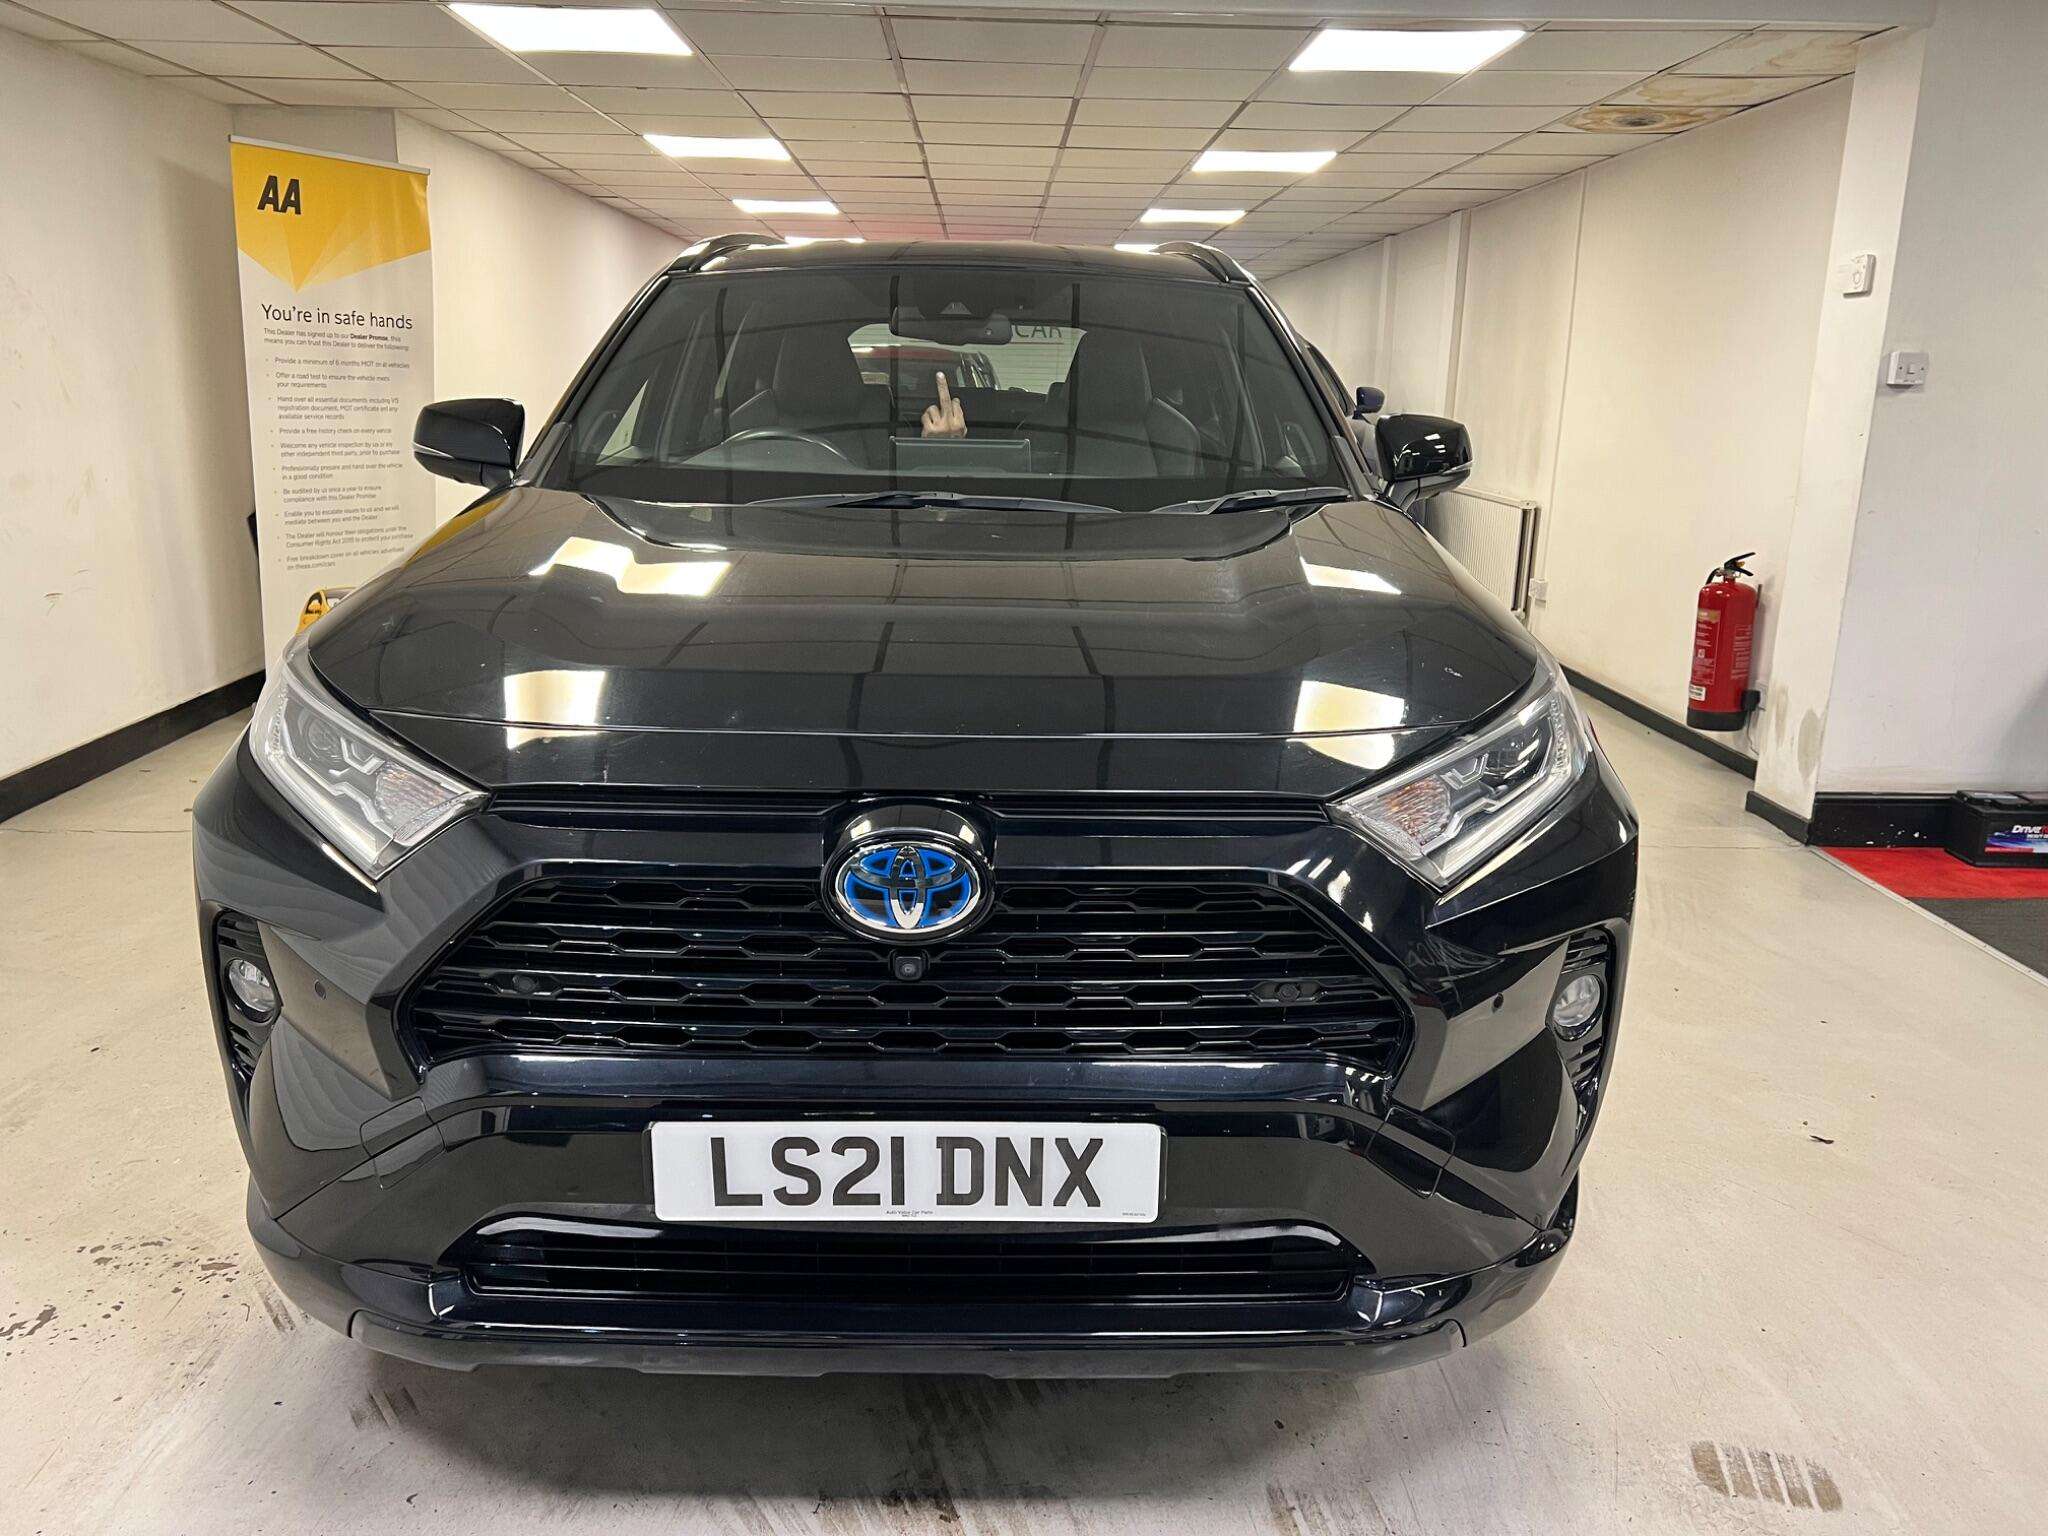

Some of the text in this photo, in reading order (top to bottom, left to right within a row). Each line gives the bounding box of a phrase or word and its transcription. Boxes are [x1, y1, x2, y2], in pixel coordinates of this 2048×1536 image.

[257, 175, 301, 215] AA
[261, 303, 413, 330] You're in safe hands
[710, 1136, 1104, 1207] LS21 DNX
